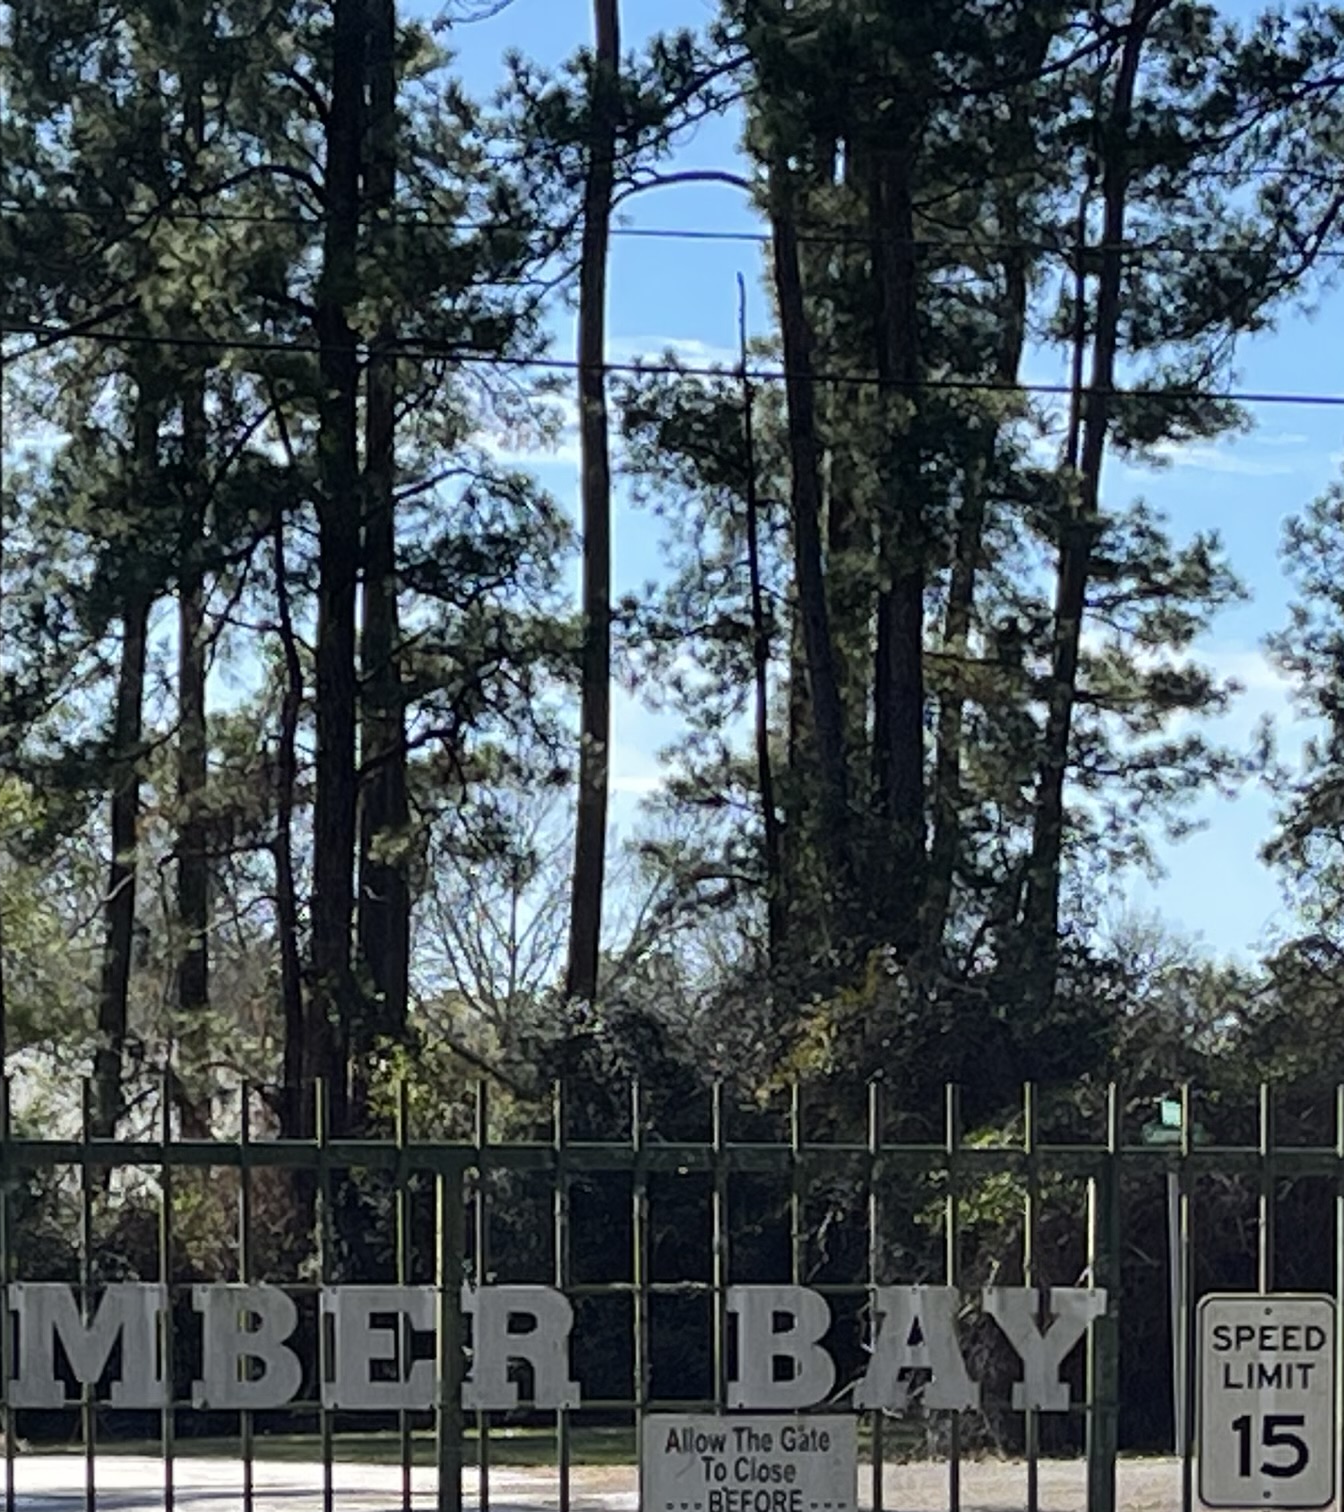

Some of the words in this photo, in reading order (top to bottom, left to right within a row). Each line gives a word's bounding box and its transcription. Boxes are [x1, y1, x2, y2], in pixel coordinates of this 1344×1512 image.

[727, 1285, 1107, 1411] BAY
[1213, 1325, 1326, 1351] SPEED
[1223, 1363, 1315, 1389] LIMIT
[665, 1427, 726, 1453] Allow
[733, 1427, 773, 1452] The
[780, 1426, 830, 1452] Gate
[1232, 1415, 1309, 1478] 15
[701, 1456, 726, 1482] To
[734, 1456, 796, 1483] Close
